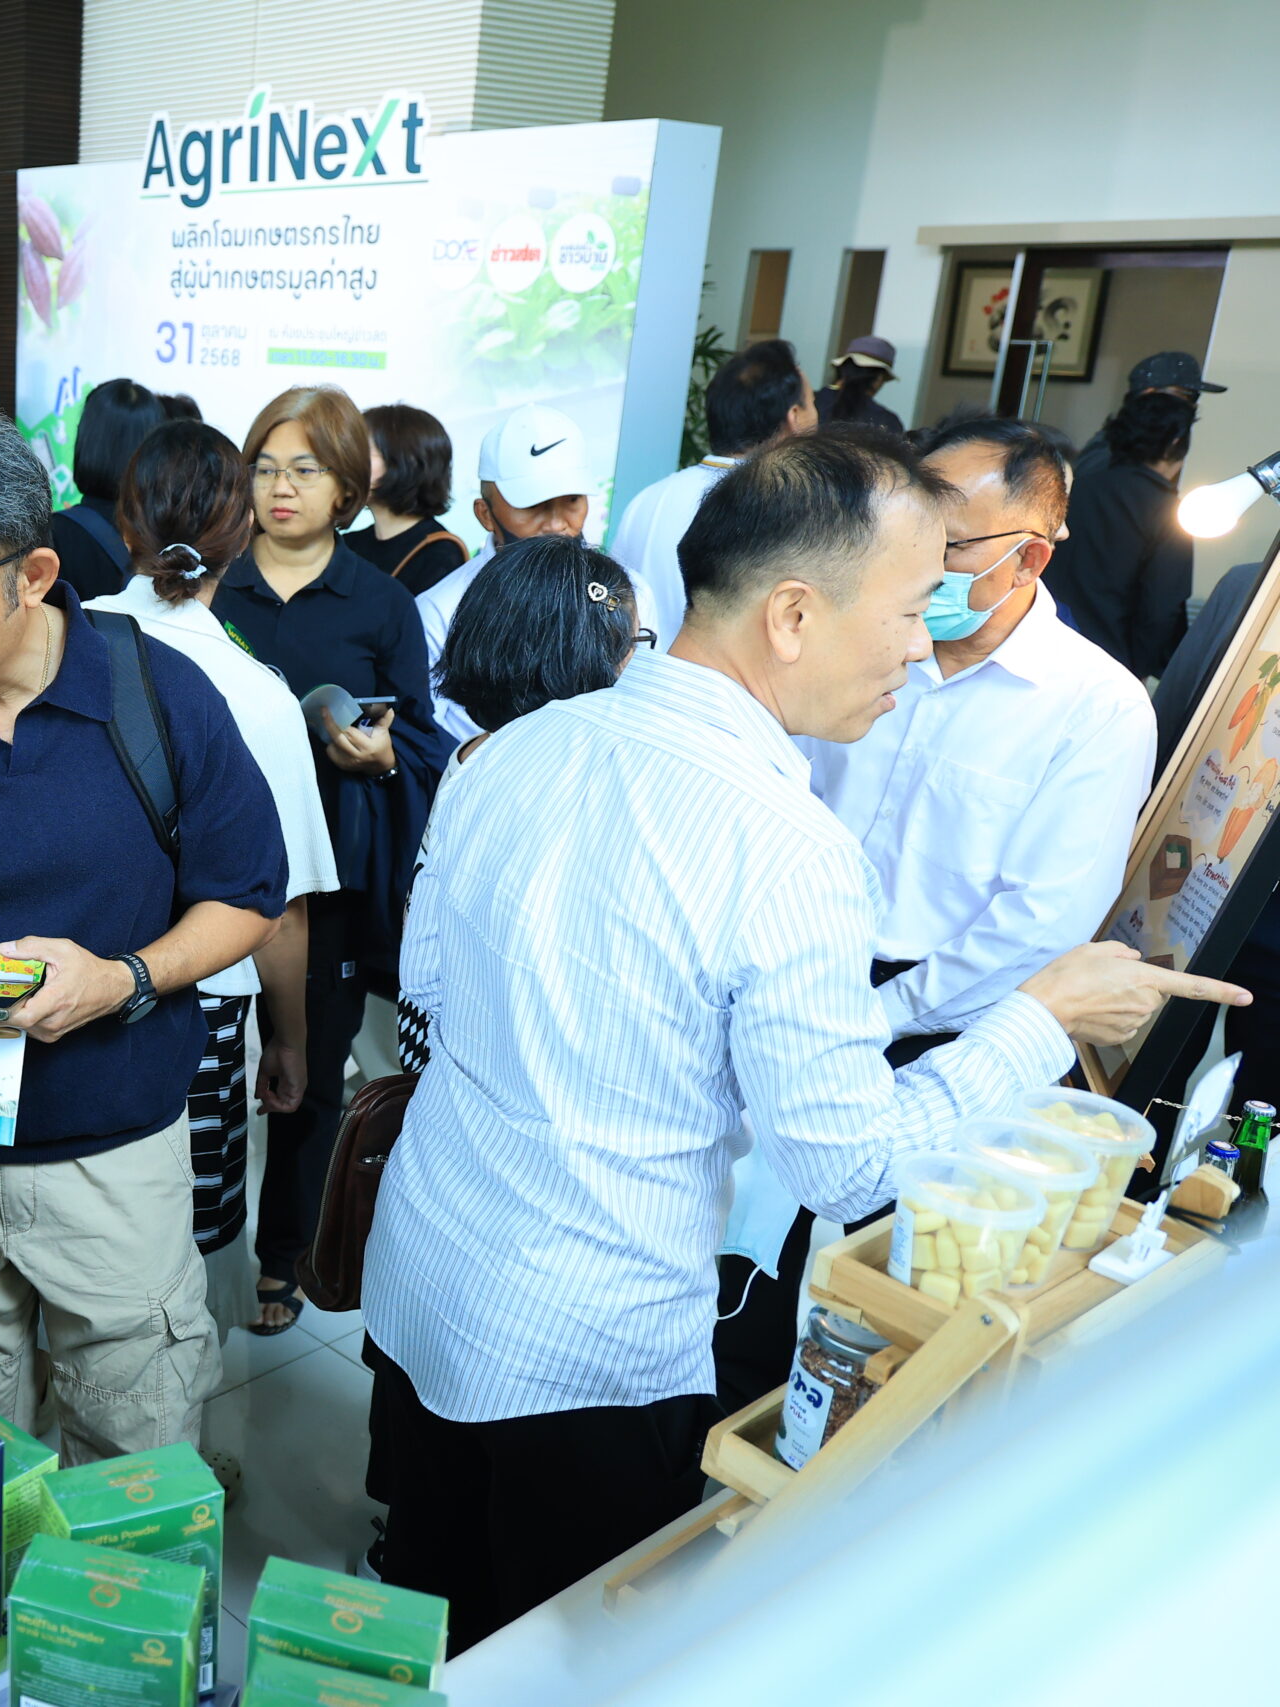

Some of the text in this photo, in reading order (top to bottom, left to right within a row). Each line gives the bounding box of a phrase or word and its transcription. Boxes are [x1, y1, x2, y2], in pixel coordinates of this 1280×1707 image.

[171, 214, 380, 249] พลิกโฉมเกษตรกรไทย
[170, 258, 378, 300] สู่ผู้นำเกษตรมูลค่าสูง
[156, 320, 195, 365] 31
[200, 324, 247, 343] ตุลาคม
[200, 347, 241, 367] 2568
[121, 1524, 161, 1540] Powder
[60, 1624, 105, 1644] Powder
